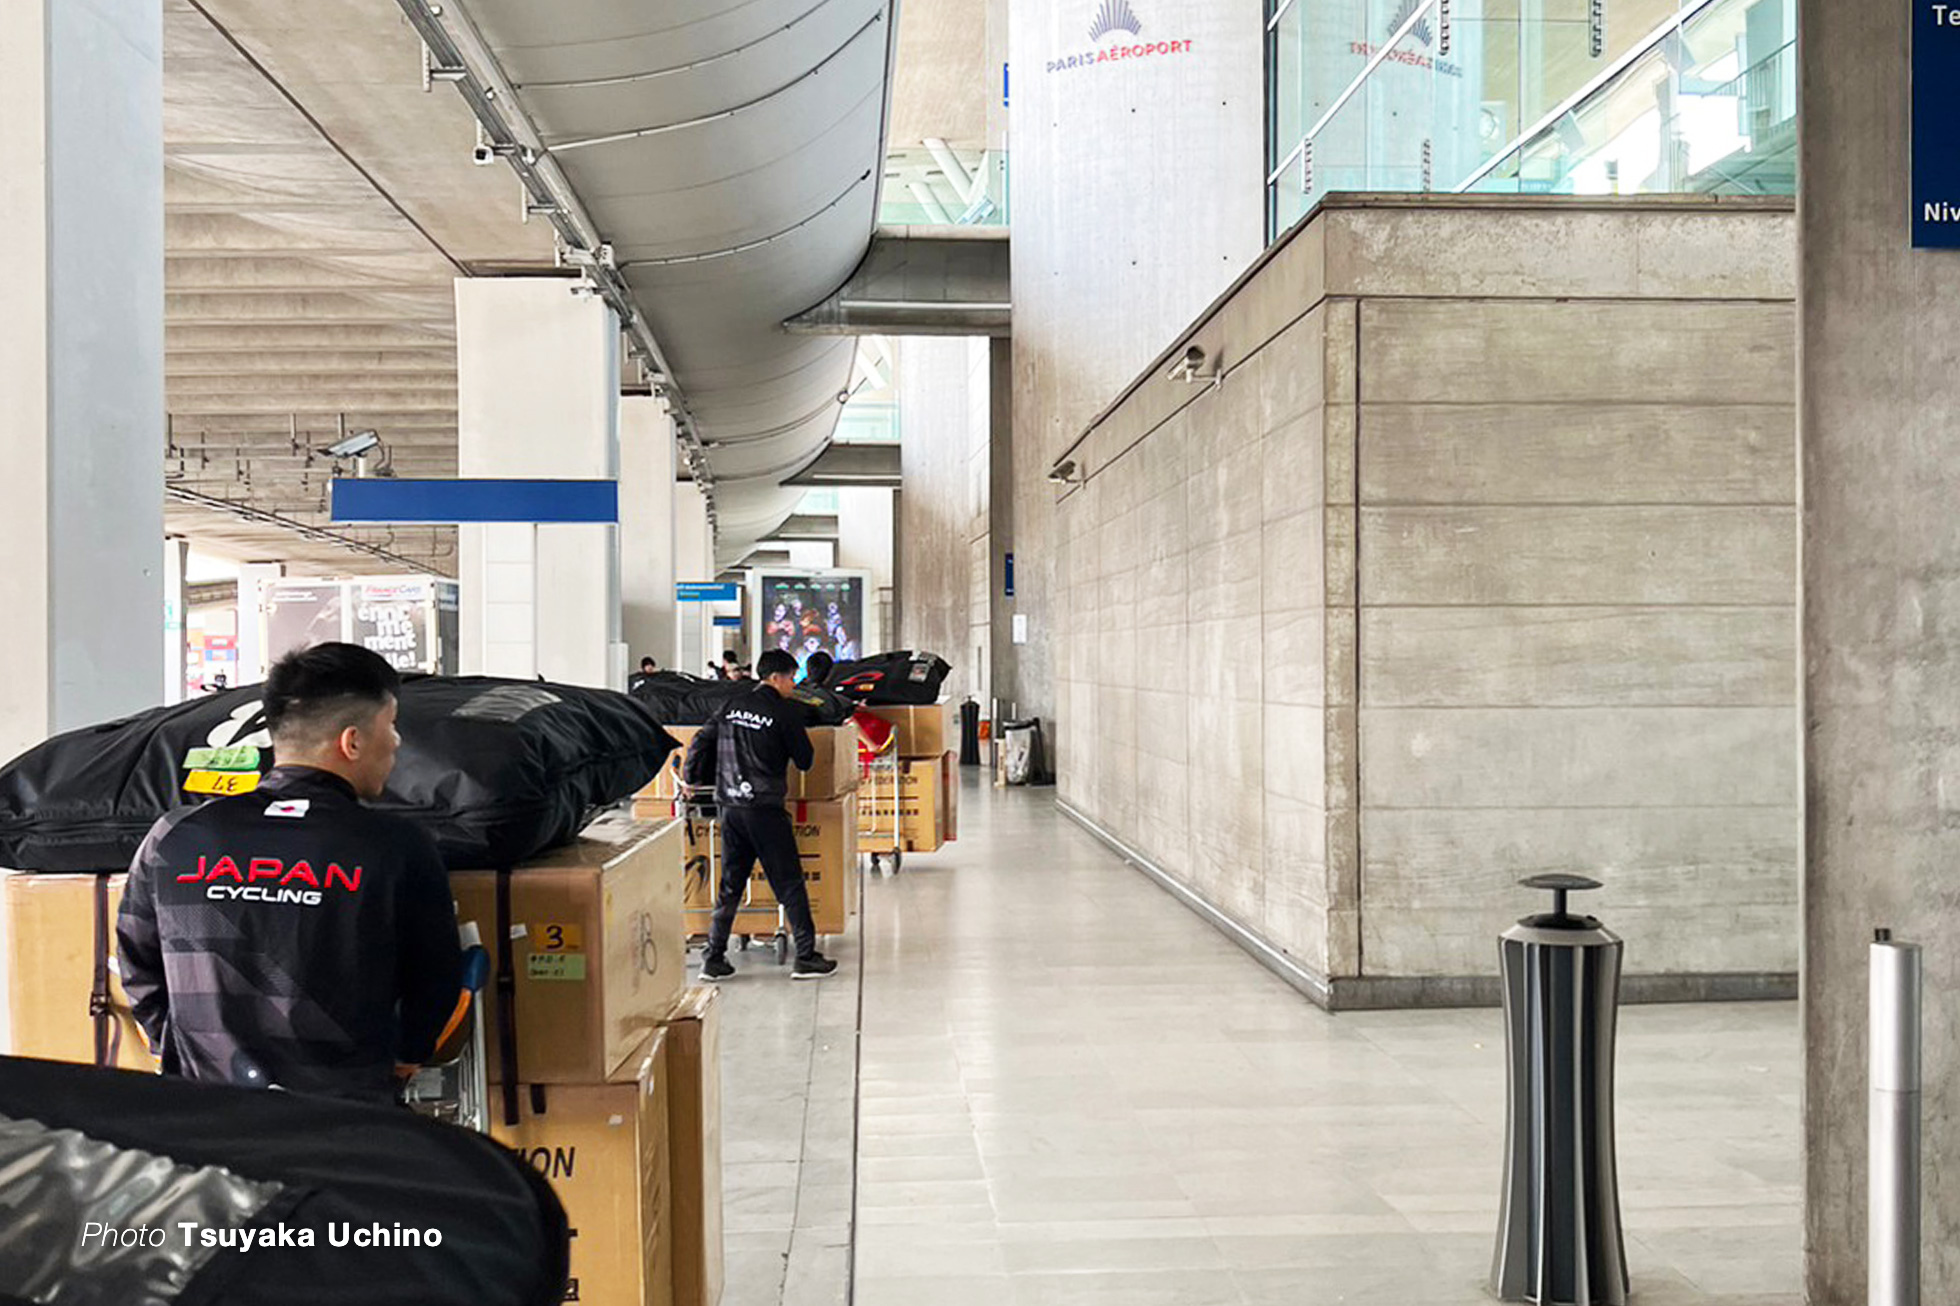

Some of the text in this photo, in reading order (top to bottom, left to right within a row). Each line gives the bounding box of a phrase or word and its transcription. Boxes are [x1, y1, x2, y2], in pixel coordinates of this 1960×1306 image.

[726, 710, 773, 727] JAPAN
[176, 855, 362, 892] JAPAN
[206, 885, 323, 905] CYCLING
[546, 925, 565, 949] 3
